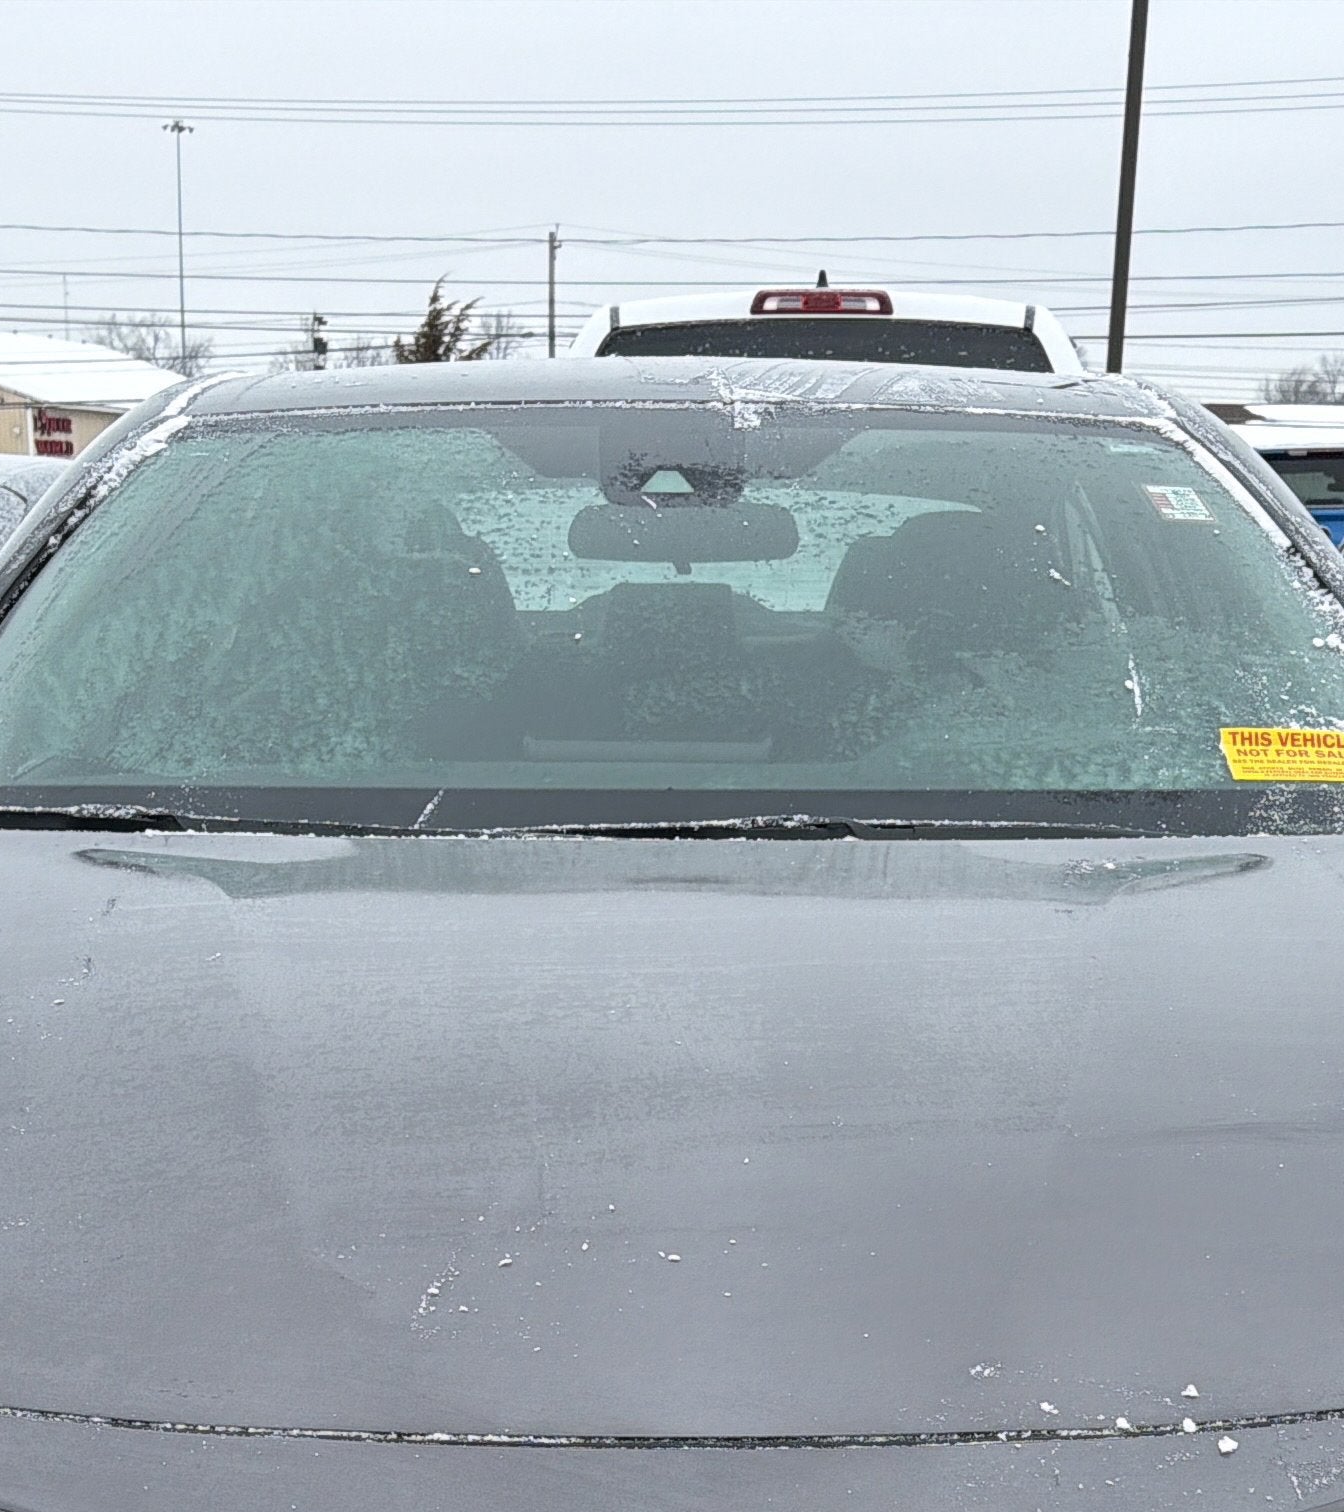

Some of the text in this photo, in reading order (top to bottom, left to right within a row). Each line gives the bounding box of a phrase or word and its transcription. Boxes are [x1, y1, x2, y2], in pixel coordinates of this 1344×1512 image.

[1227, 731, 1272, 747] THIS
[1236, 748, 1269, 758] NOT
[1275, 749, 1311, 758] FOR
